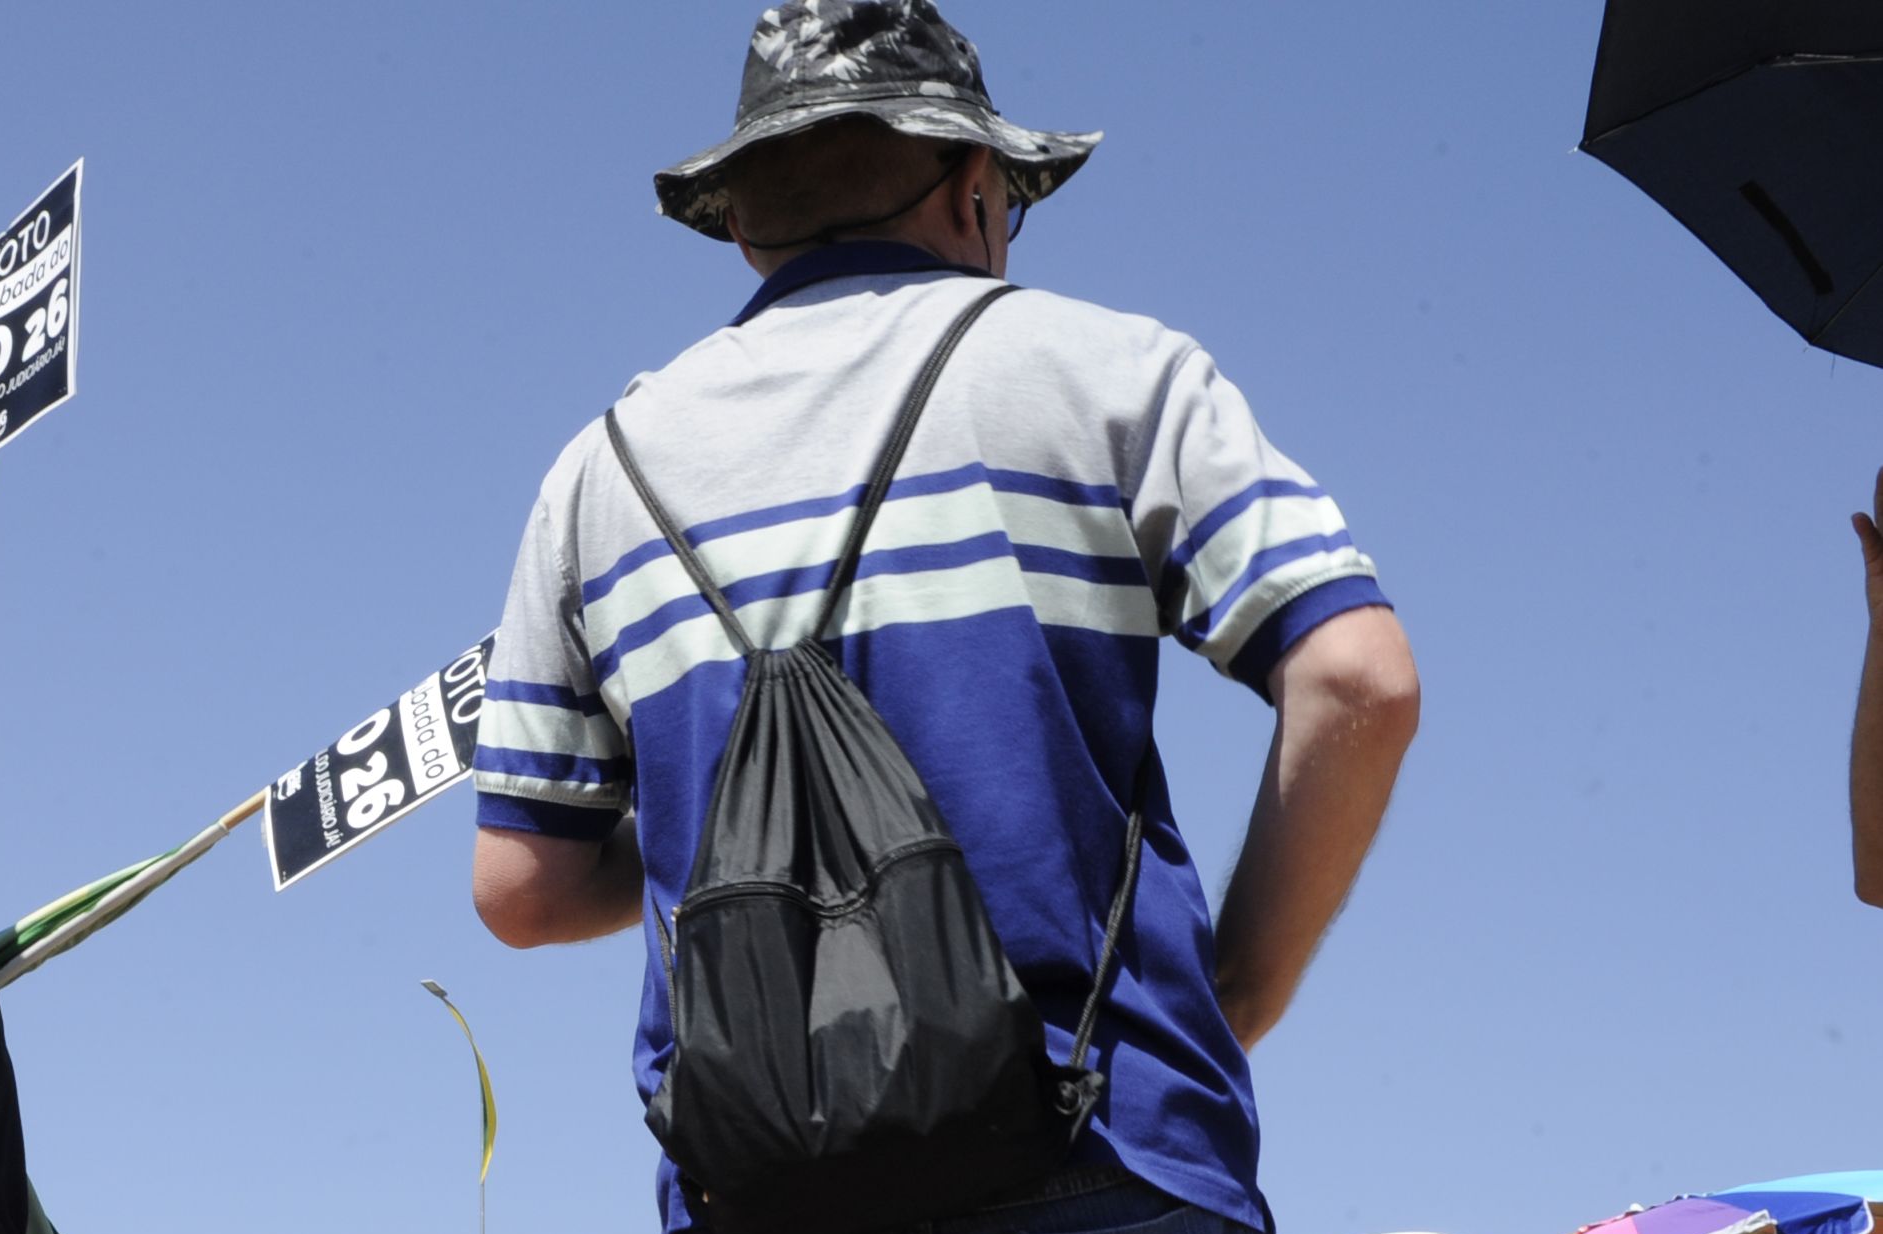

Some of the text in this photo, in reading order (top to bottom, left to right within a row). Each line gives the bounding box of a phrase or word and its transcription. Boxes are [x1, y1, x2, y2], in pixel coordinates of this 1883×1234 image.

[50, 240, 69, 270] do
[22, 278, 69, 362] 26
[444, 645, 486, 724] OTO
[340, 750, 406, 829] 26
[421, 746, 449, 780] do
